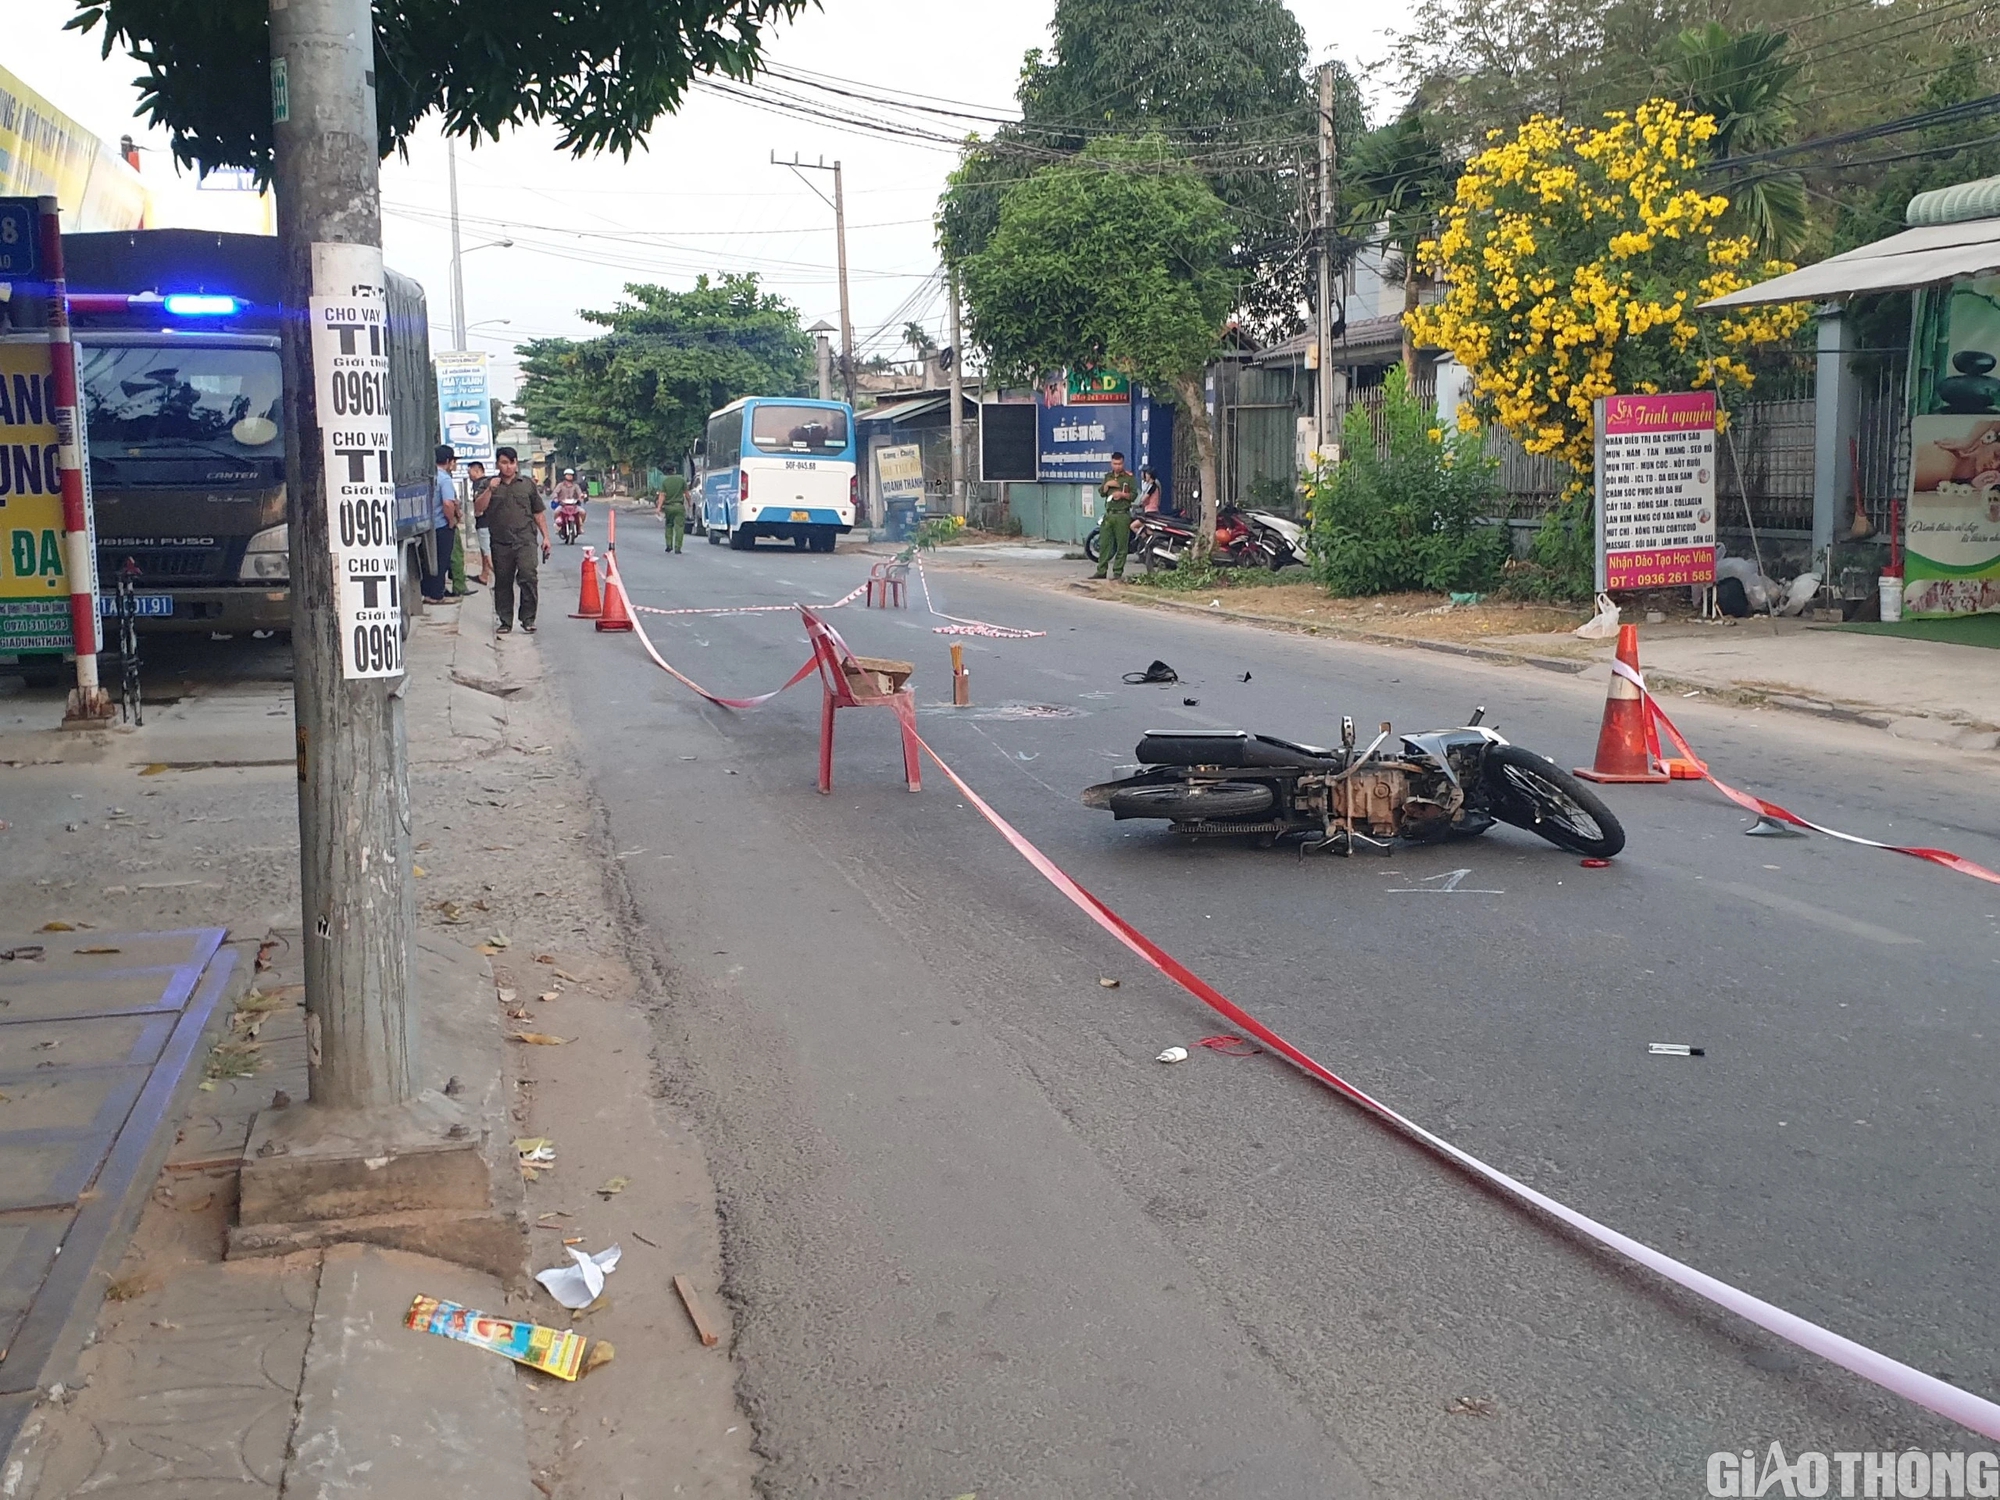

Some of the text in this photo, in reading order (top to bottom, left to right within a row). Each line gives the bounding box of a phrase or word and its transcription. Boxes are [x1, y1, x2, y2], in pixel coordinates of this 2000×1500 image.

[325, 308, 381, 322] CHO VAY
[333, 358, 365, 367] Giới
[333, 432, 389, 447] CHO VAY
[335, 449, 394, 483] TI
[341, 485, 373, 495] Giới
[1674, 497, 1702, 507] COLLAGEN
[1620, 514, 1632, 523] KIM
[1606, 540, 1630, 550] MASSAGE
[12, 530, 66, 587] ĐẠ
[348, 558, 379, 572] CHO
[1609, 555, 1633, 571] Nhận
[1654, 553, 1671, 569] Tạo
[1673, 553, 1691, 567] Học
[1692, 551, 1712, 563] Viên
[1610, 570, 1712, 587] ĐT 0936 261 585
[356, 611, 386, 621] Giới
